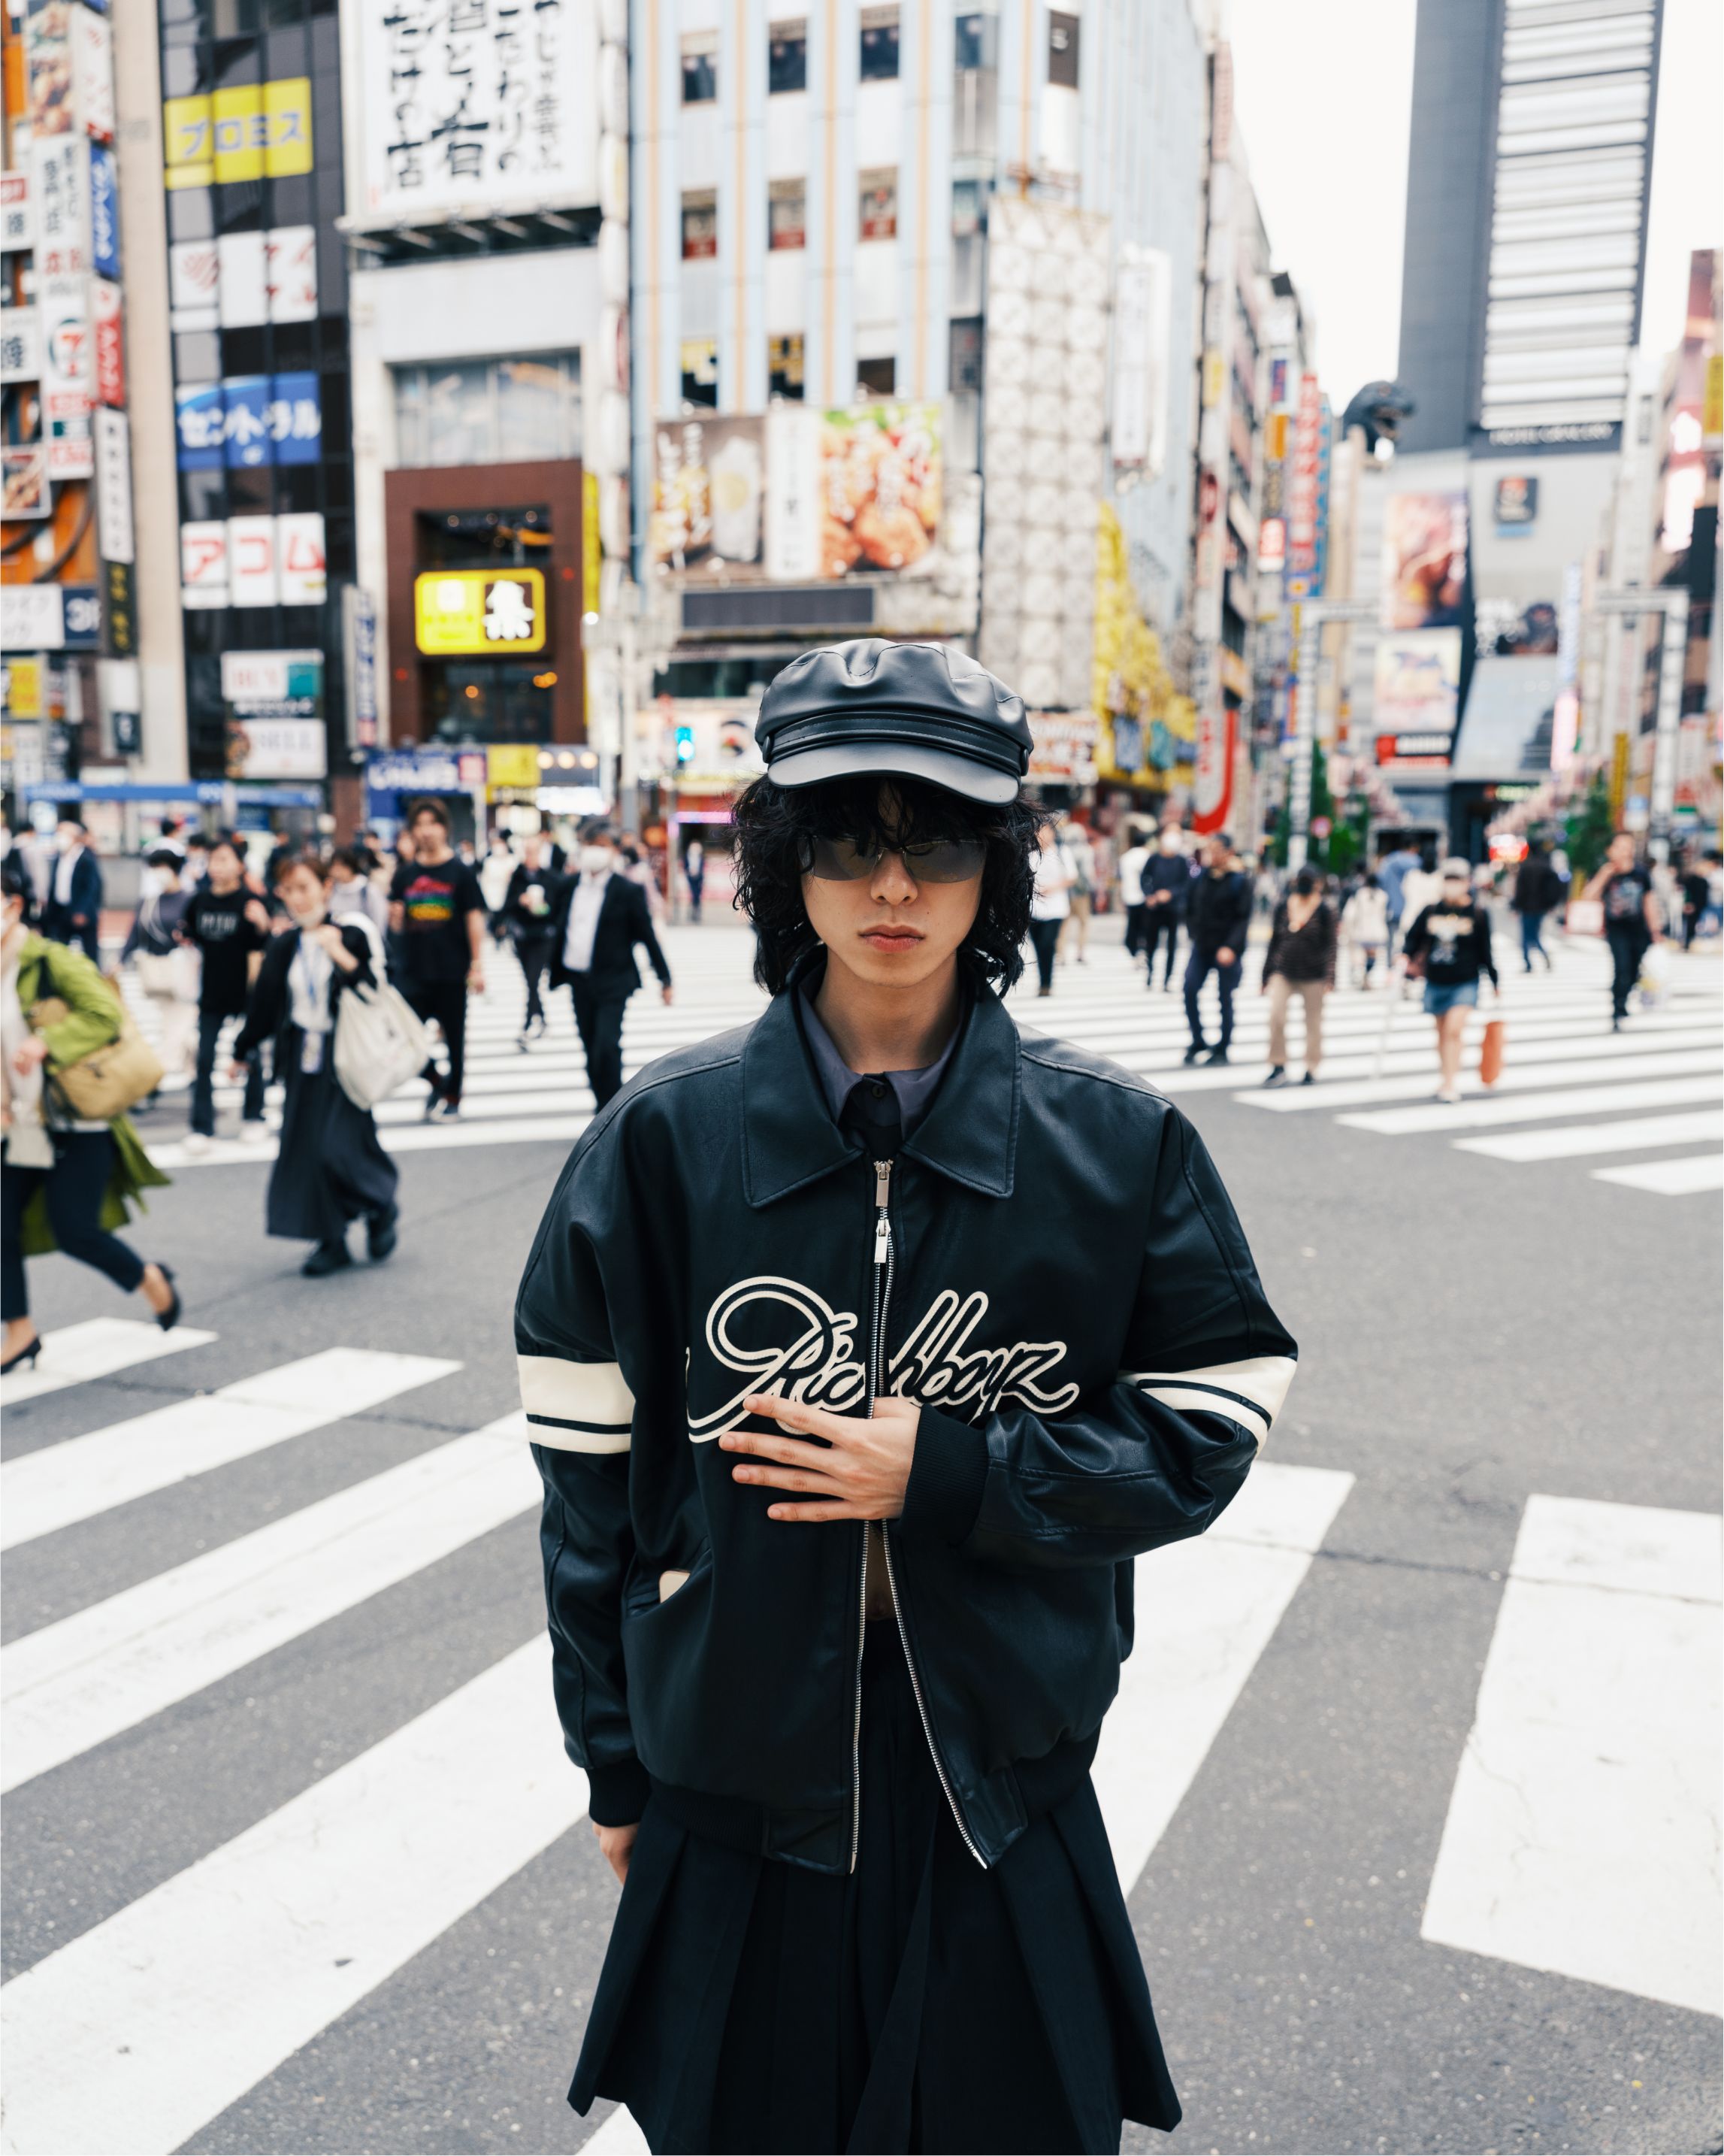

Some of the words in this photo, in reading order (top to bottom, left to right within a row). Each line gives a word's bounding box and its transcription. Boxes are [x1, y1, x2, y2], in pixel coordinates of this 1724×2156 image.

[382, 3, 425, 194] だけの店
[493, 8, 529, 171] こだわりの
[179, 112, 306, 159] プロミス
[179, 398, 322, 449] セントラル
[184, 536, 325, 579] アコム
